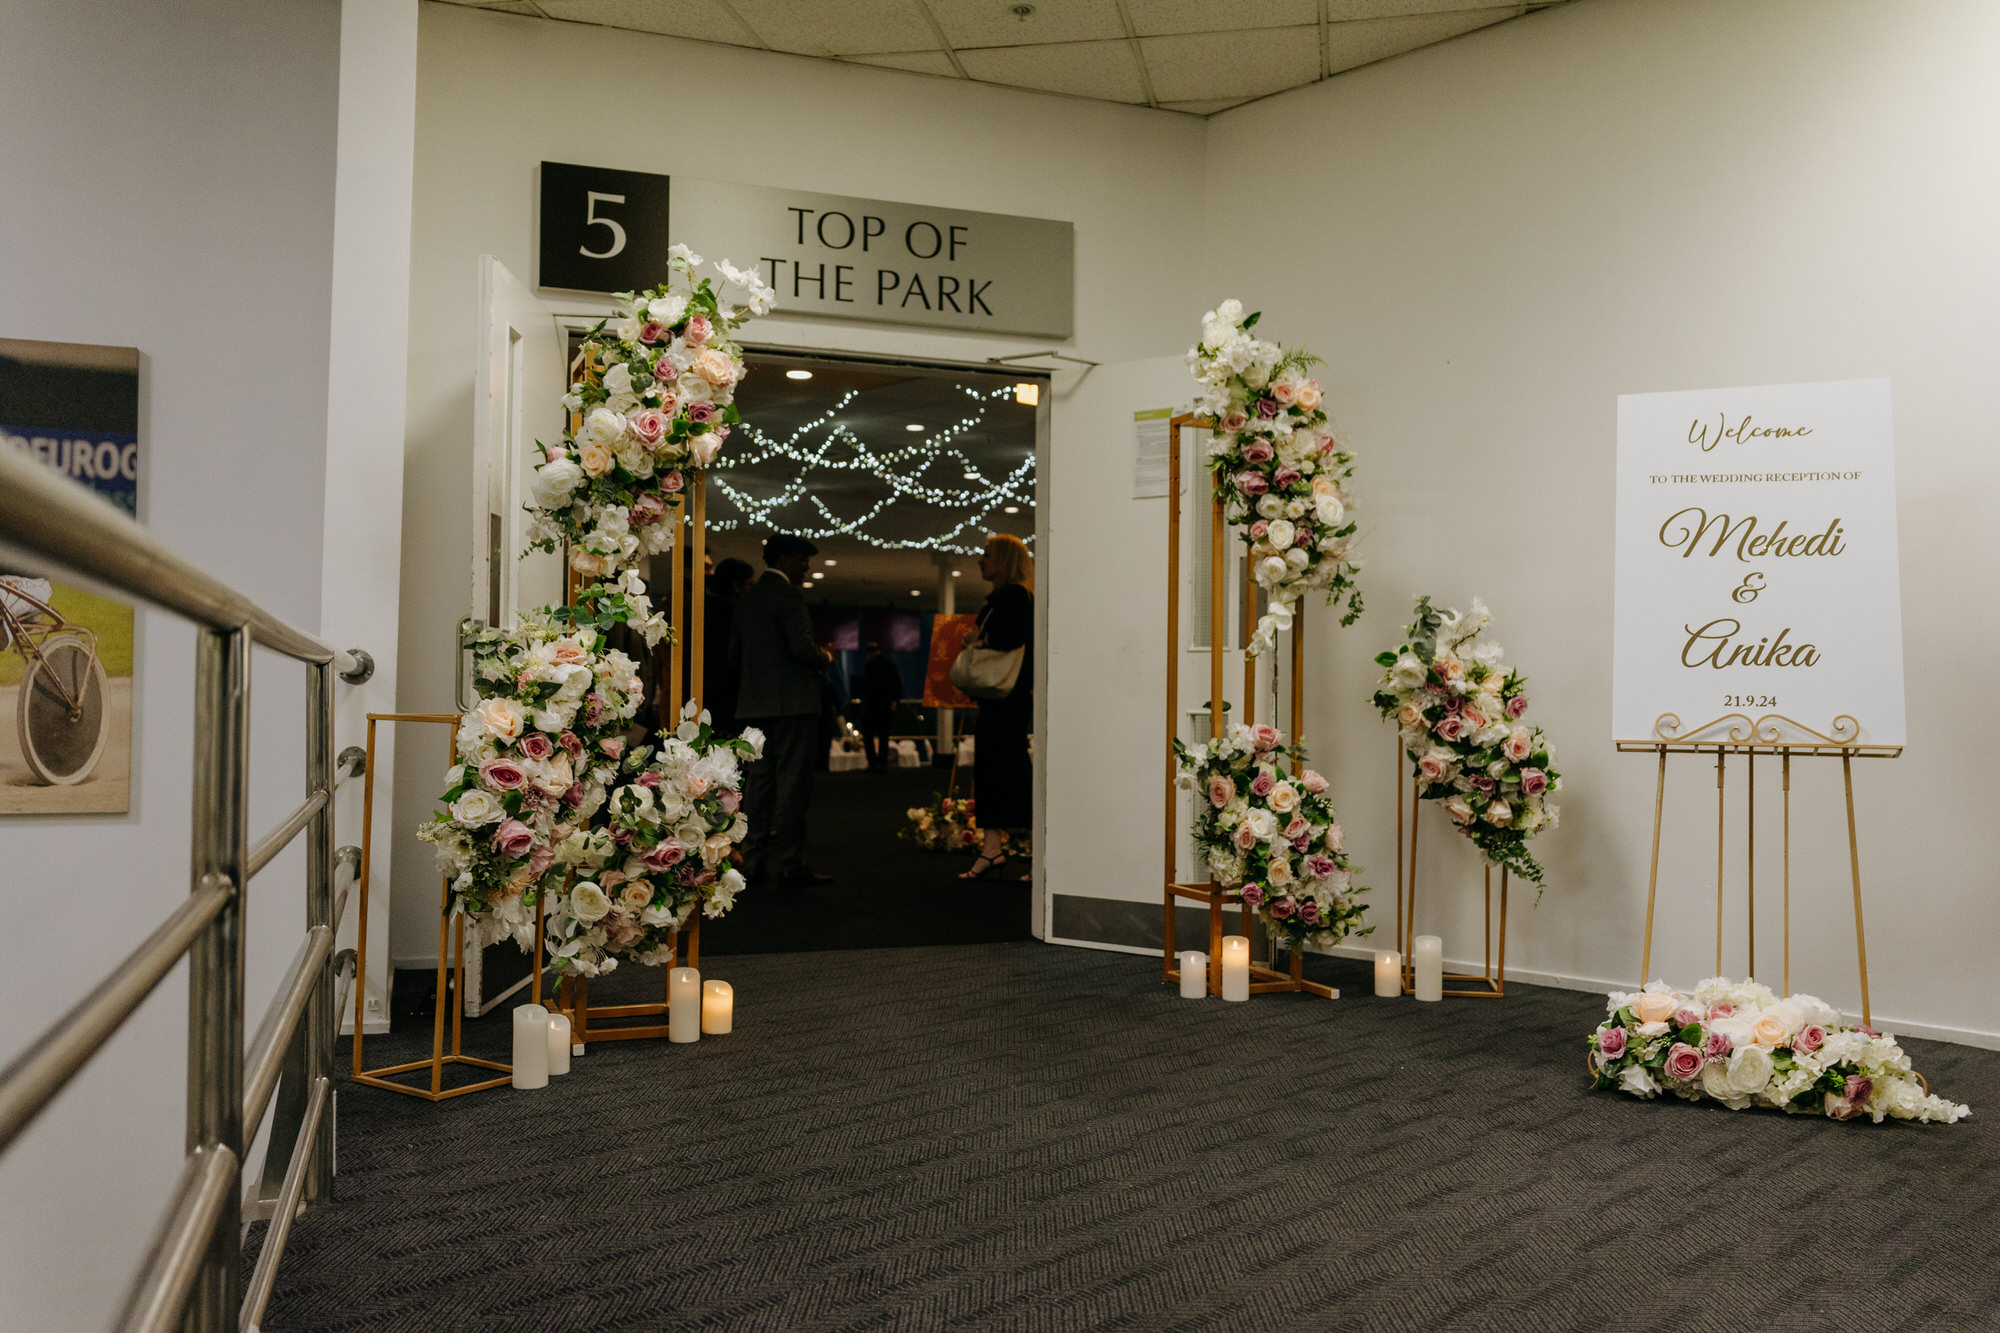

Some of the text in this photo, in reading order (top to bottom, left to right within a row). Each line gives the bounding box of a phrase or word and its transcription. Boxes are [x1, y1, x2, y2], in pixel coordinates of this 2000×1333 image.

[579, 190, 627, 259] 5
[787, 207, 968, 261] TOP OF
[760, 257, 993, 316] THE PARK
[1688, 412, 1814, 452] Welcome
[1649, 471, 1862, 484] TO THE WEDDING RECEPTION OF
[1659, 507, 1846, 562] Mehedi
[1731, 571, 1767, 604] &
[1681, 618, 1821, 669] Anika
[1723, 694, 1777, 707] 21.9.24
